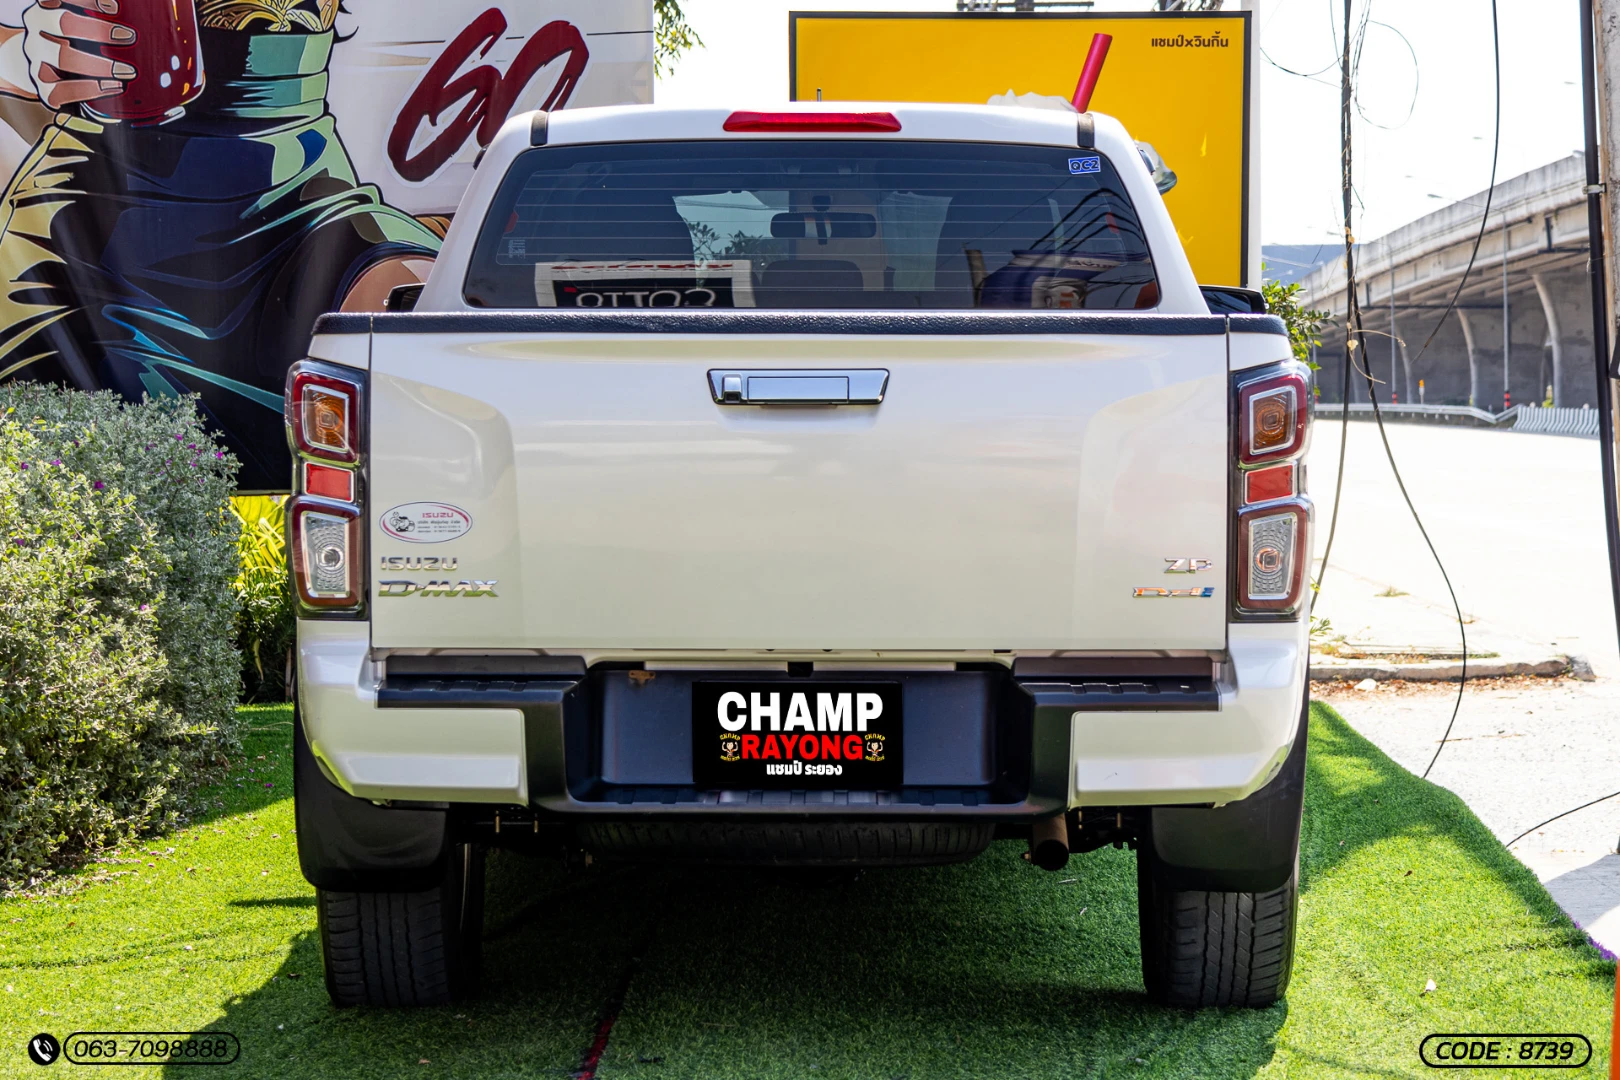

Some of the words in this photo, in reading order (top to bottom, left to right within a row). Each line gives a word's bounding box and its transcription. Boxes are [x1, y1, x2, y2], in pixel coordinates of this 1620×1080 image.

[1070, 159, 1099, 171] QC2
[380, 556, 458, 571] ISUZU
[1164, 558, 1213, 574] ZP
